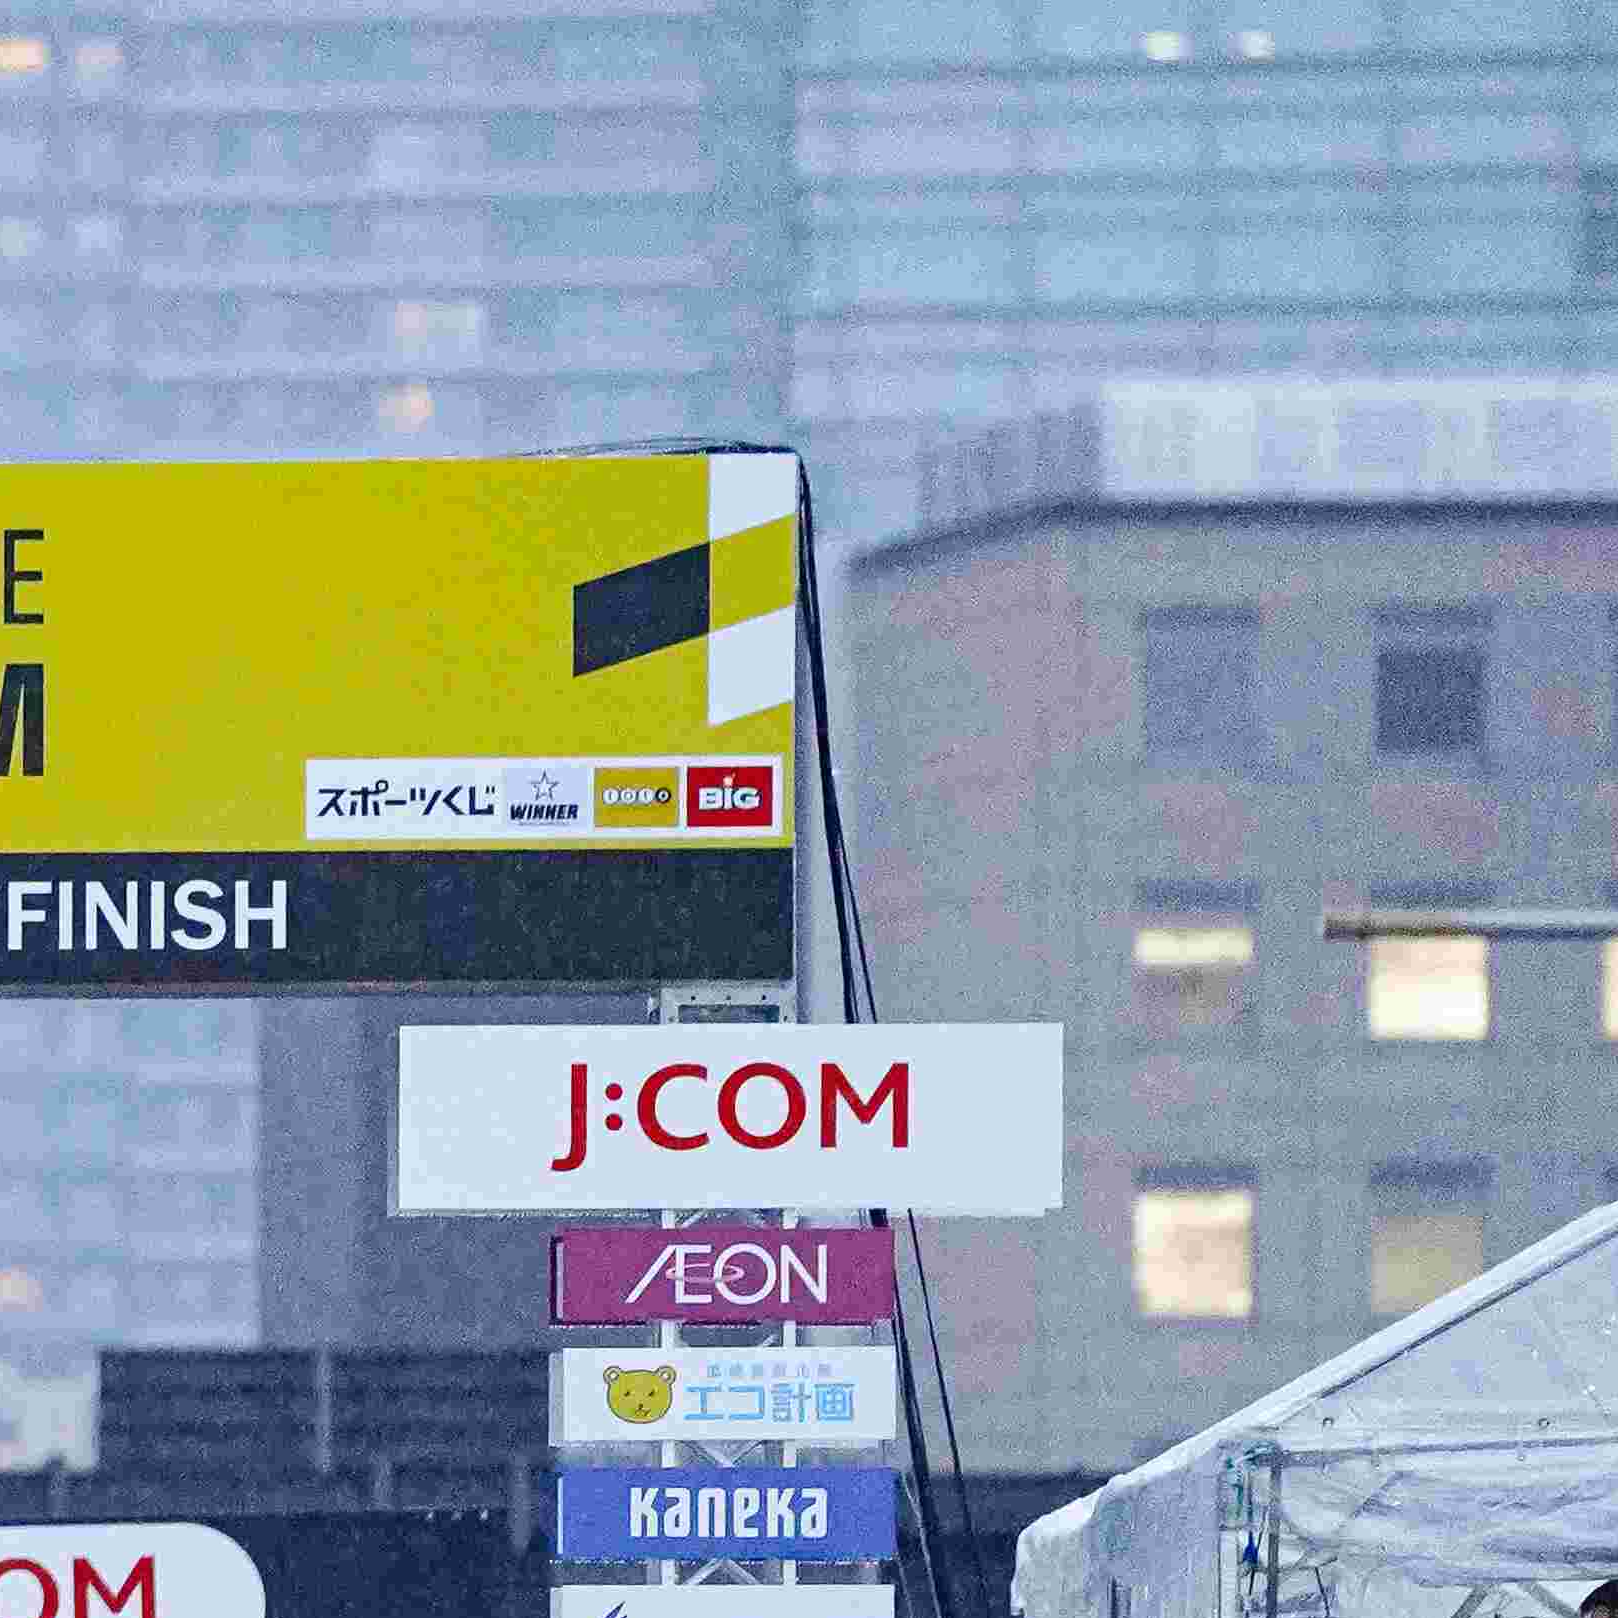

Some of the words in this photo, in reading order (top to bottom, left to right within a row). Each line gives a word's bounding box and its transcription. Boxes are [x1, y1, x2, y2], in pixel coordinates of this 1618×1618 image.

[317, 780, 497, 818] スポーツくじ
[509, 803, 580, 821] WINNER
[550, 1062, 911, 1172] J:COM
[683, 1382, 855, 1423] エコ計画
